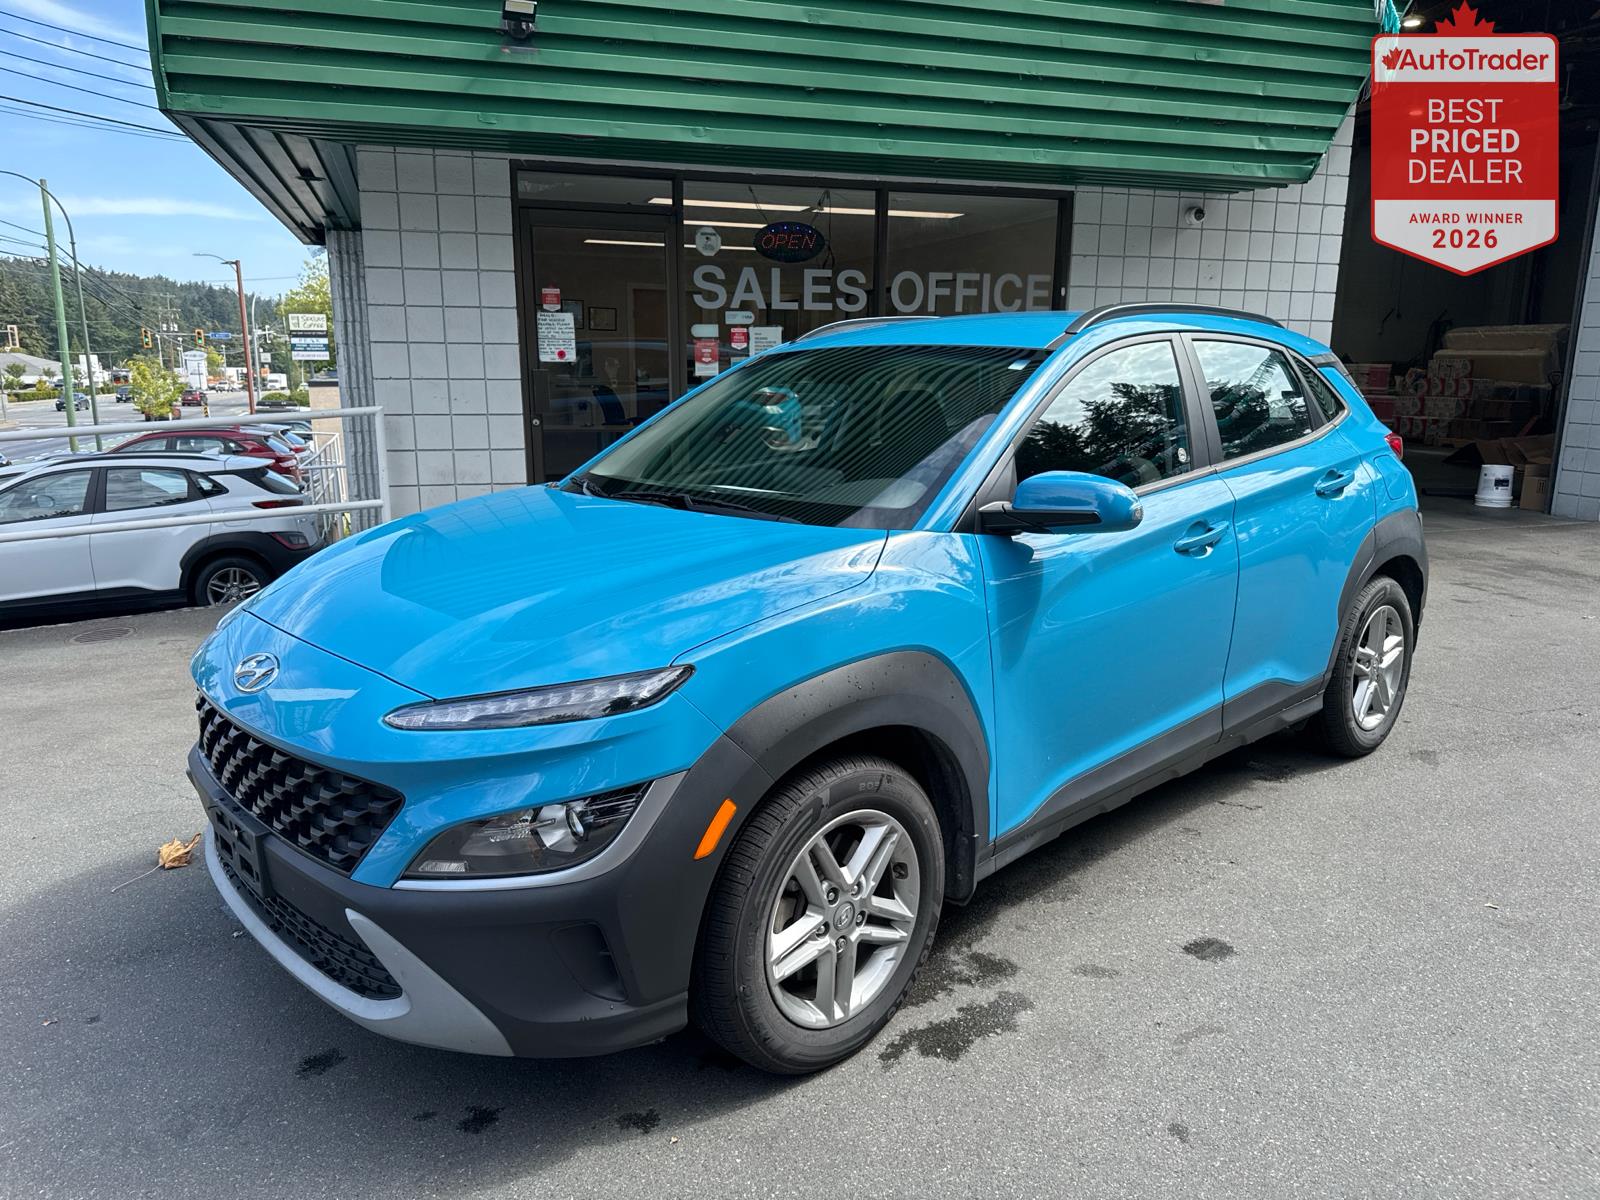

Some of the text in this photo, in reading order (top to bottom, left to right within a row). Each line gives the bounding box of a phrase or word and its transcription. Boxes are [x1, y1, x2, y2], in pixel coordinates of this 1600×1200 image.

[762, 234, 817, 249] OPEN
[692, 264, 1051, 313] SALES OFFICE
